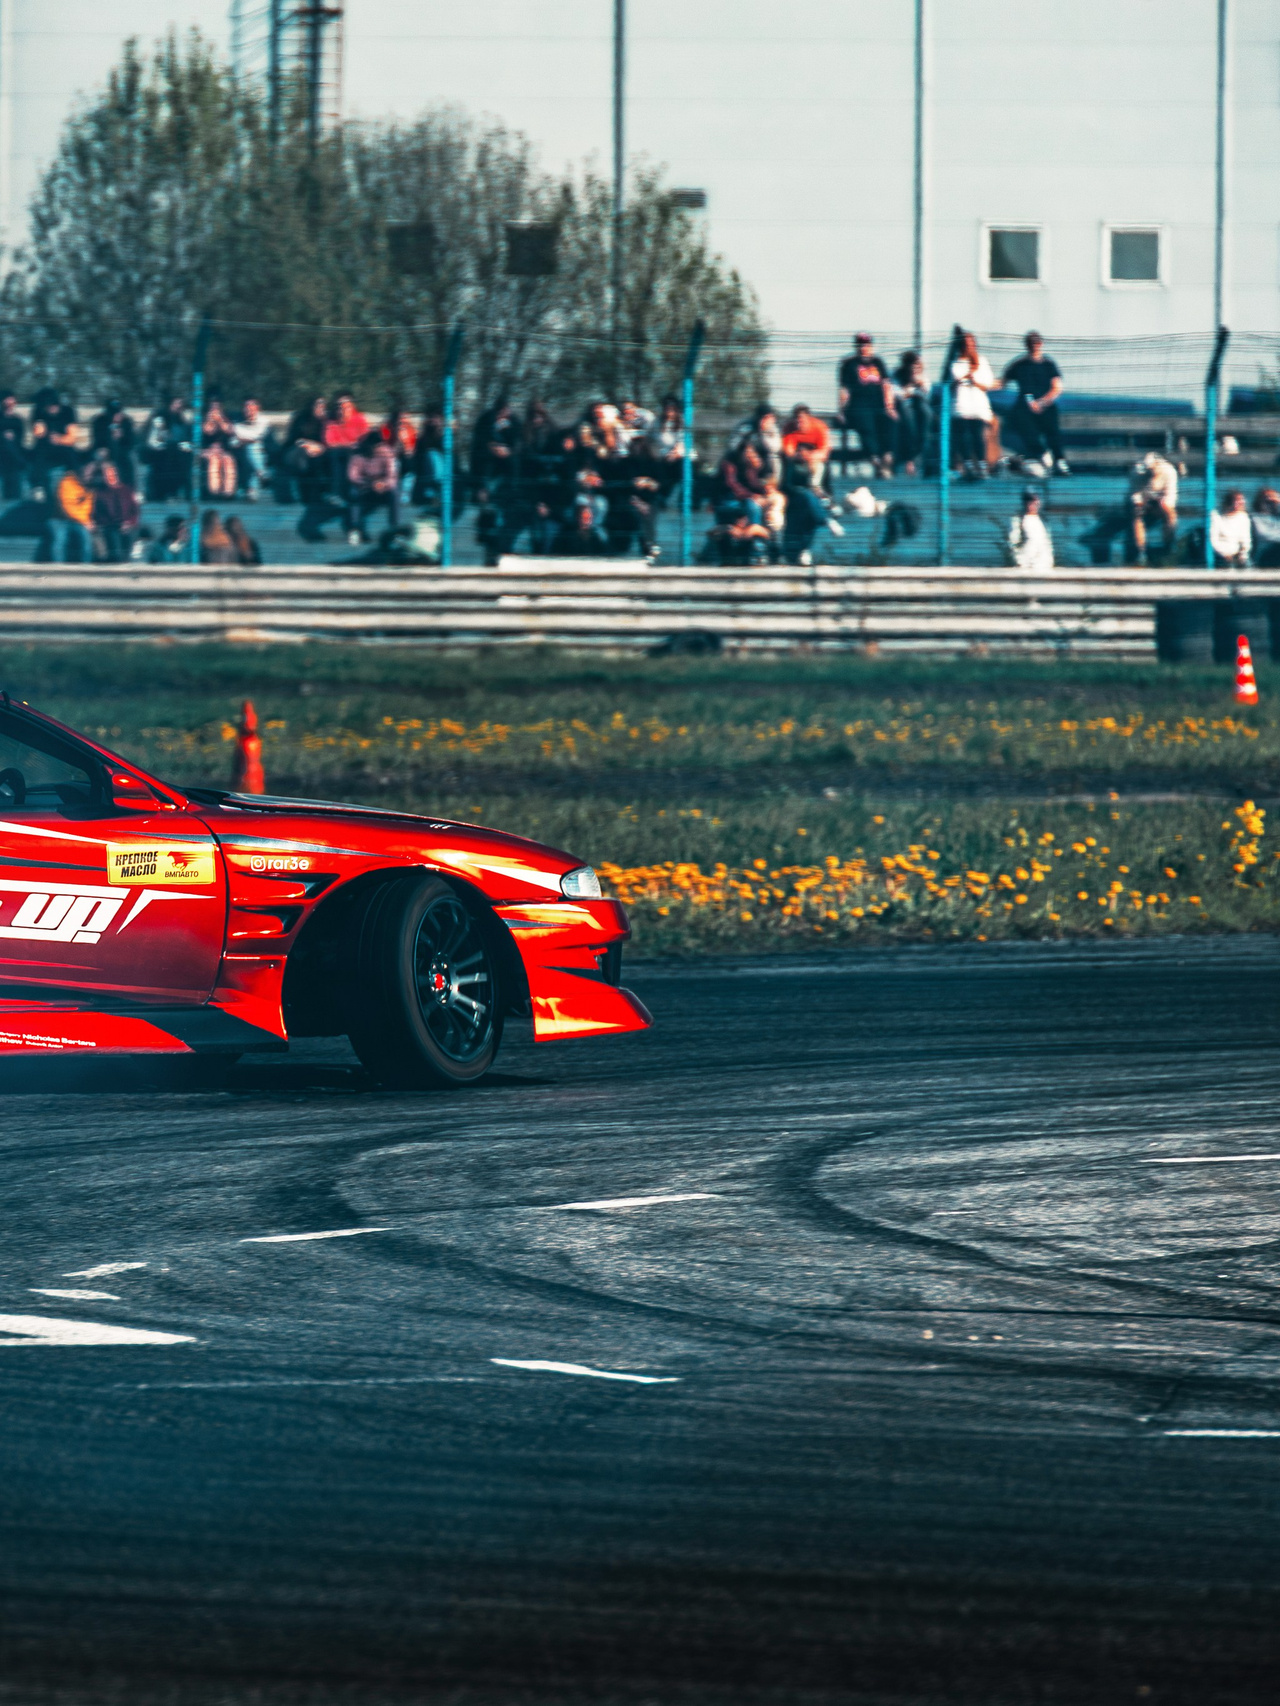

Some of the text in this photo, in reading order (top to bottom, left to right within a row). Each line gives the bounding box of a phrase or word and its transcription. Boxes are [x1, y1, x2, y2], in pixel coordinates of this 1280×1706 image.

[115, 851, 158, 866] КРЕПКОЕ
[267, 857, 310, 870] rar3e
[120, 863, 157, 878] МАСЛО
[164, 870, 199, 878] ВМПАВТО
[22, 1033, 61, 1043] Nicholas
